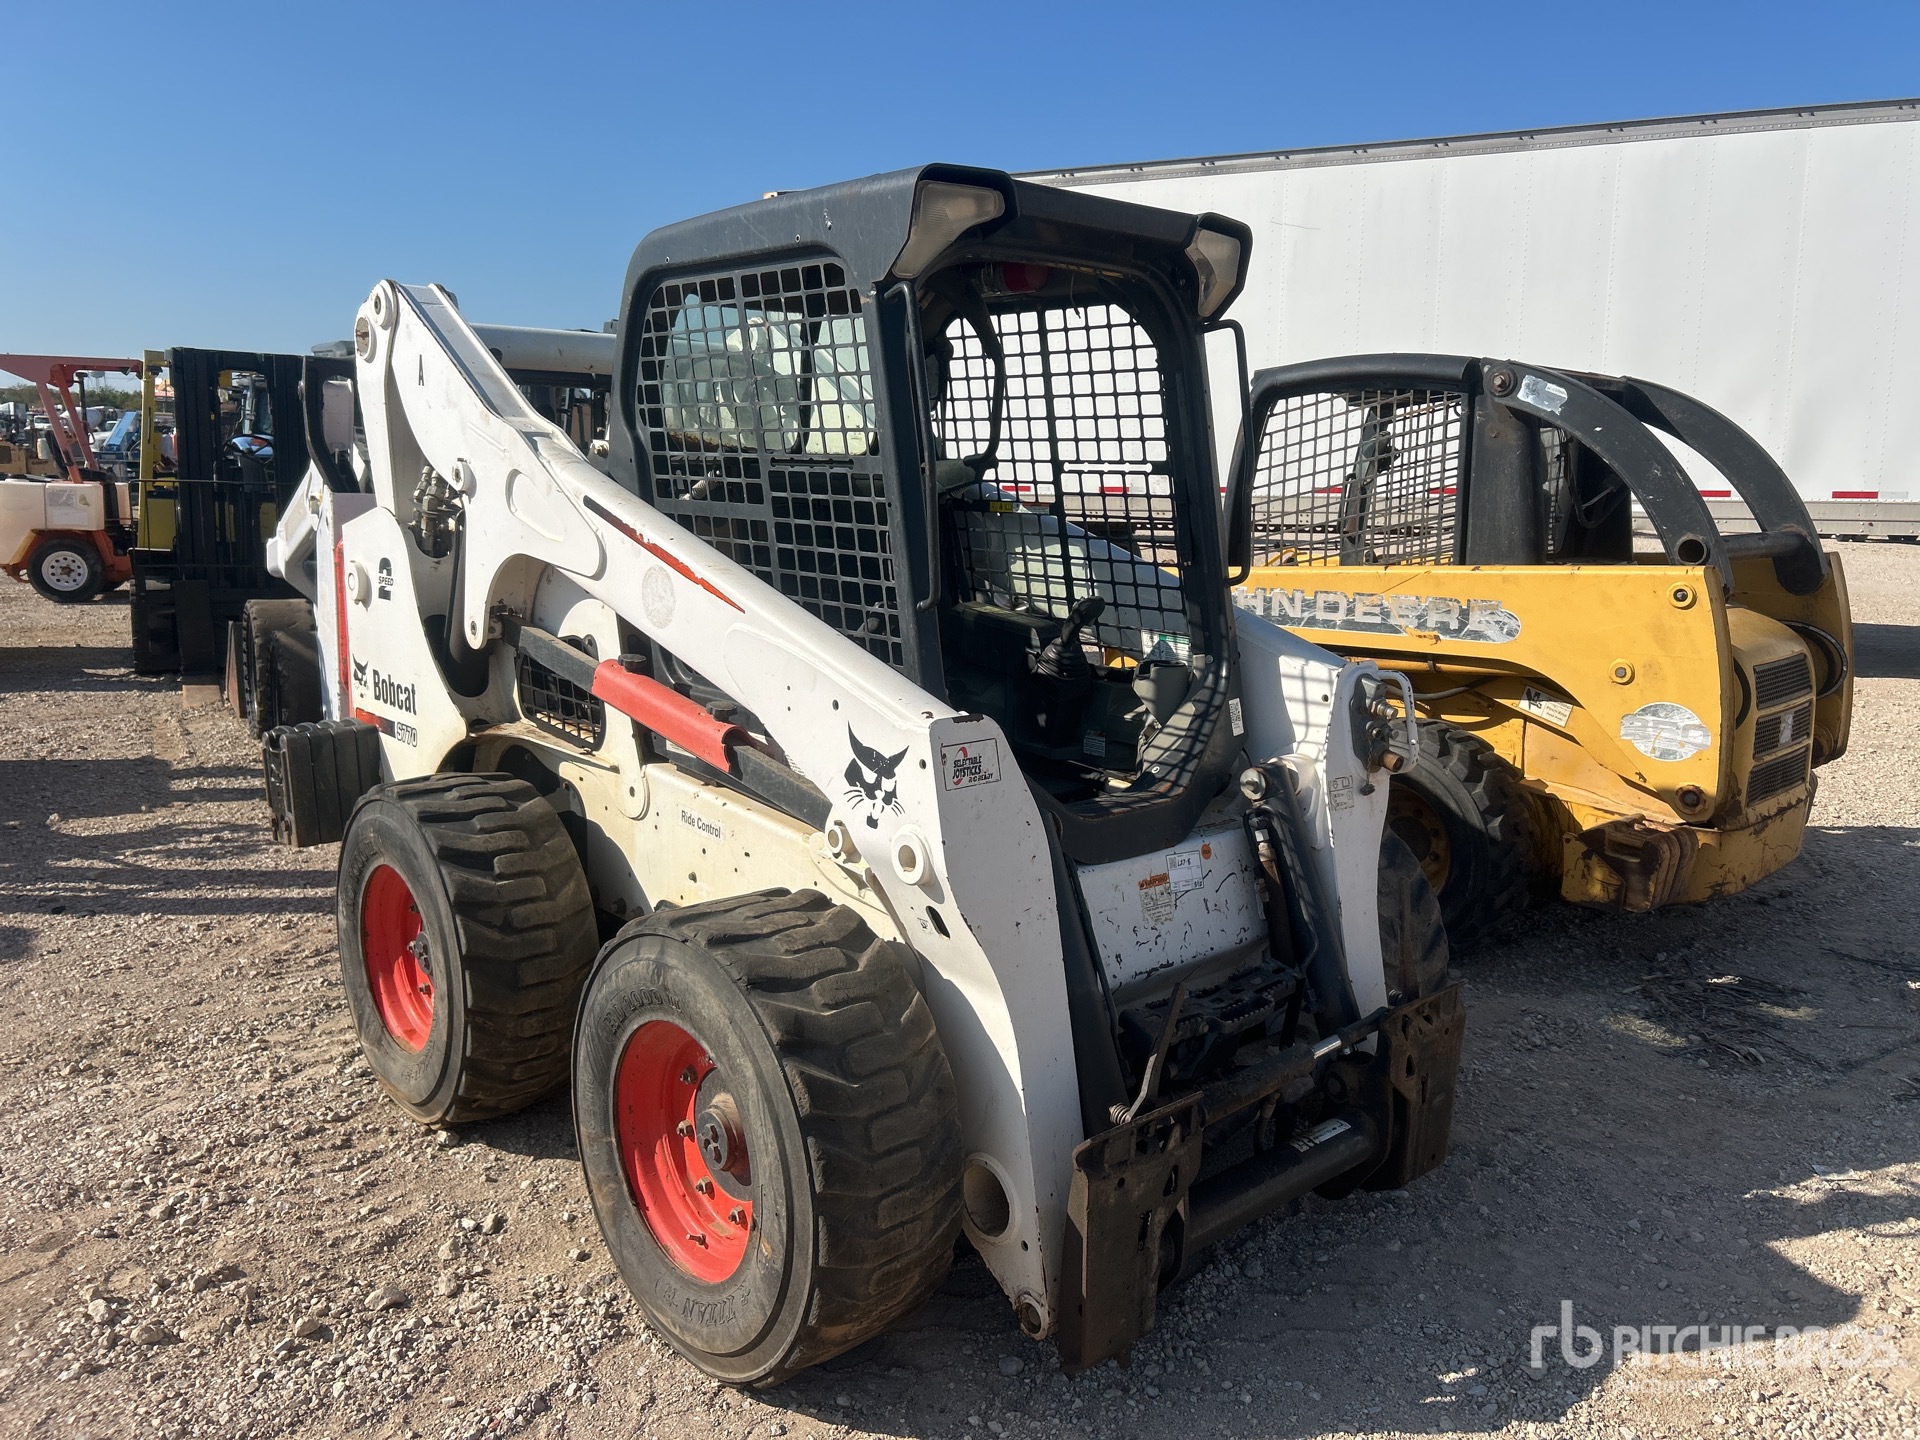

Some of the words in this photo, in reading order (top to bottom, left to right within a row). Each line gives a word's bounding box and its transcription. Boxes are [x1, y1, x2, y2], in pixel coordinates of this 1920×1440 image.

[378, 575, 394, 586] SPEED
[1314, 589, 1503, 632] DEERE
[372, 668, 417, 716] Bobcat
[396, 721, 418, 748] S770
[952, 765, 982, 780] JOYSTICKS
[953, 755, 982, 768] SELECTABLE
[681, 809, 696, 827] Ride
[696, 817, 721, 839] Control
[682, 1295, 736, 1327] TITAN
